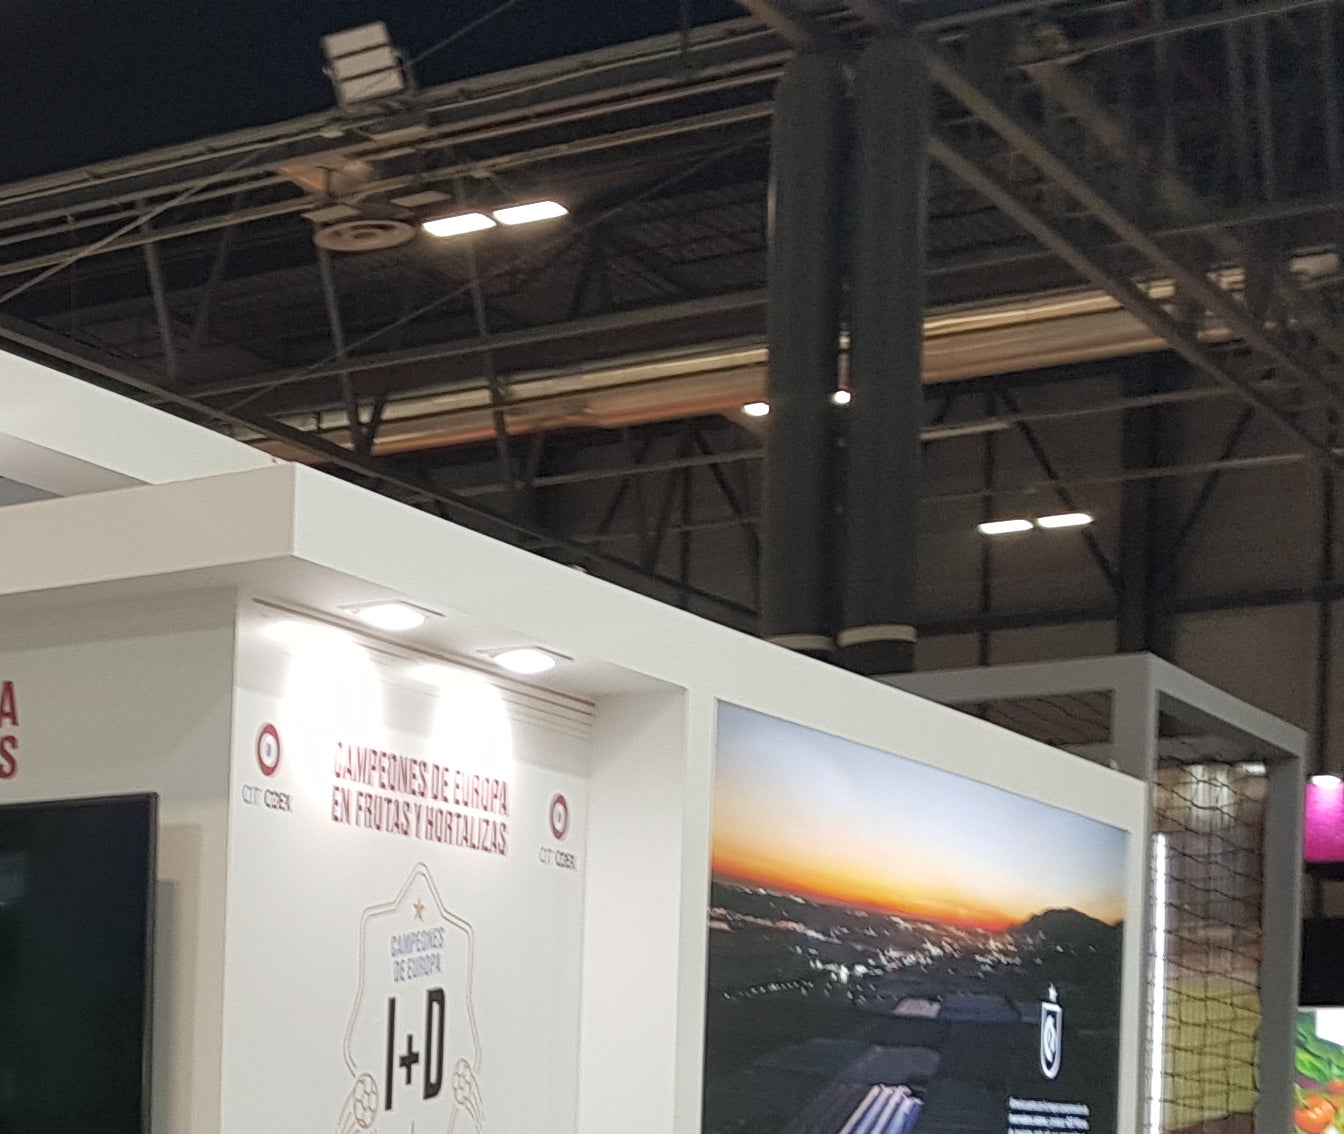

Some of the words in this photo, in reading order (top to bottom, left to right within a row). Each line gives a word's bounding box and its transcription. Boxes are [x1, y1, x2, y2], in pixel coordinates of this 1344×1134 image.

[333, 741, 430, 799] CAMPEONES
[431, 763, 450, 804] DE
[453, 769, 510, 817] EUROPA
[331, 785, 352, 828] EN
[355, 789, 412, 838] FRUTAS
[413, 801, 424, 841] Y
[424, 806, 508, 857] HORTALIZAS
[384, 987, 446, 1111] I+D
